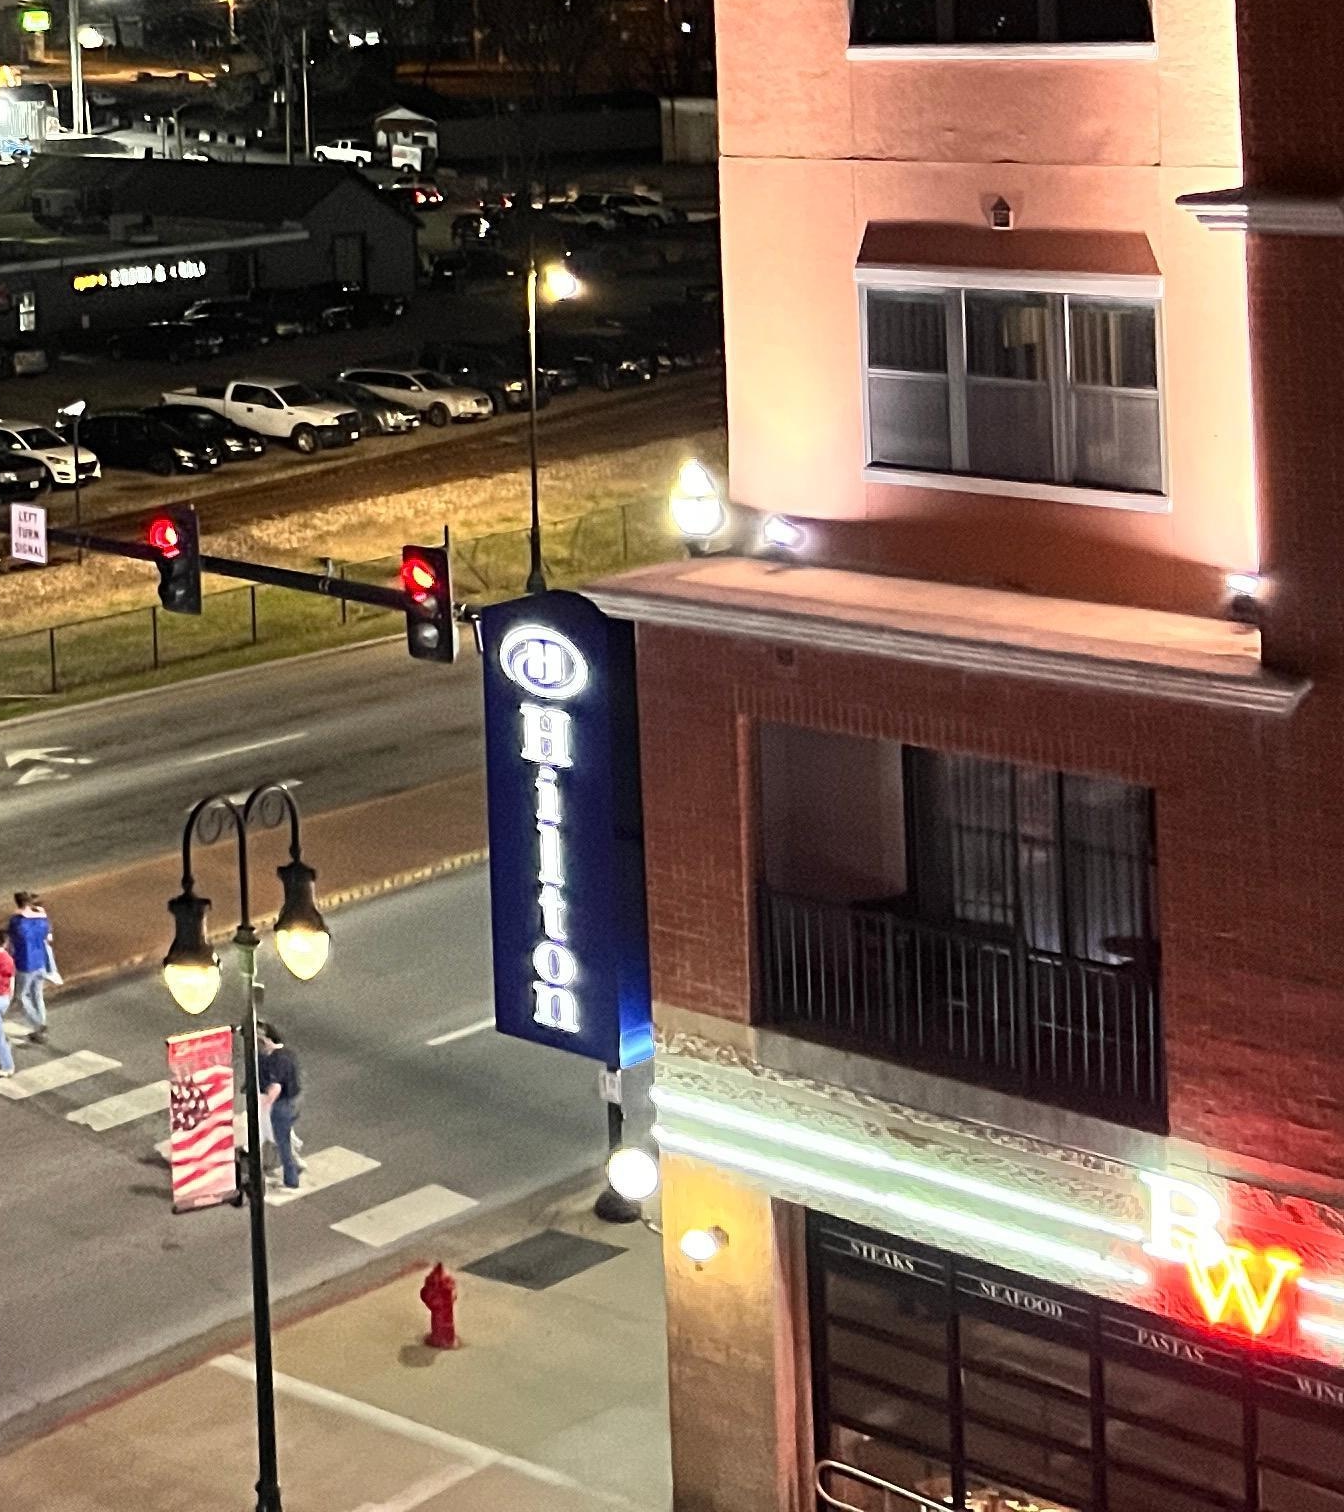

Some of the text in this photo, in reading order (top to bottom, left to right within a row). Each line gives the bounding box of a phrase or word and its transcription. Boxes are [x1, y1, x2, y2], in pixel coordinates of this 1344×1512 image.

[18, 511, 38, 523] LEFT
[18, 526, 40, 539] TURN
[14, 542, 44, 558] SIGNAL
[519, 704, 580, 1033] Hilton
[850, 1240, 915, 1272] STEAKS
[979, 1281, 1063, 1318] SEAFOOD
[1137, 1328, 1205, 1372] PASTAS
